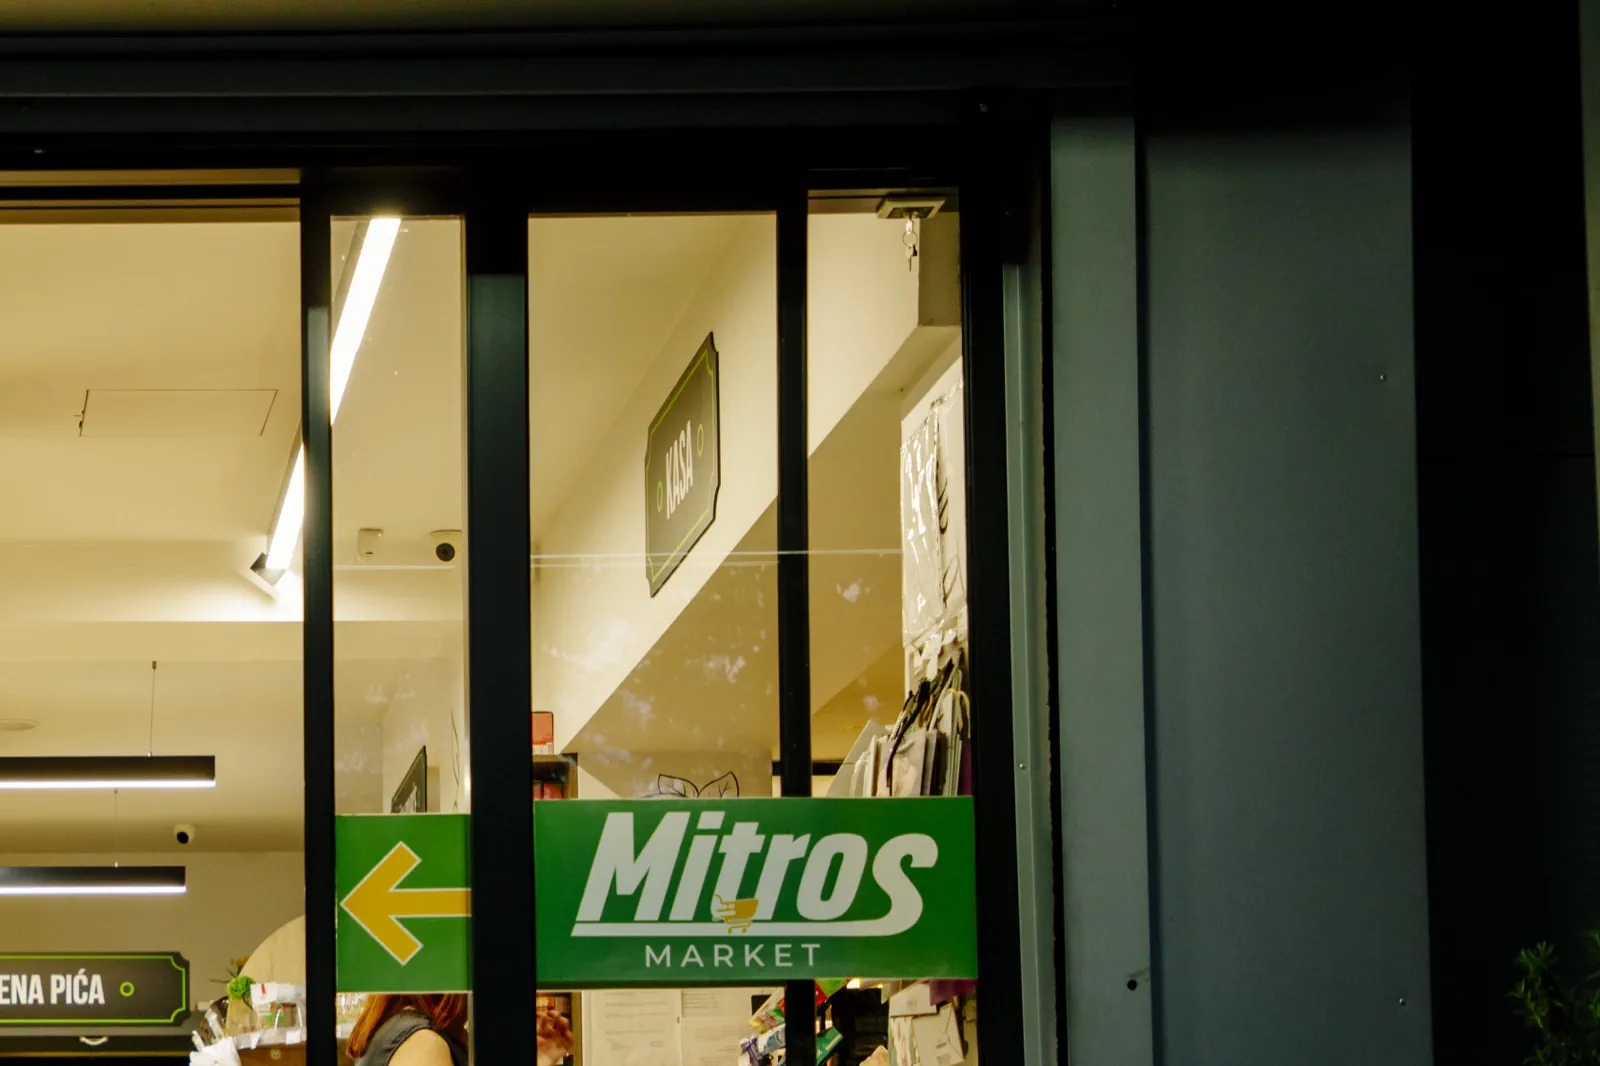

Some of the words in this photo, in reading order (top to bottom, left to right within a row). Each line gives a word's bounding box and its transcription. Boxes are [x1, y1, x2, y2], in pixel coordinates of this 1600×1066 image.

[665, 420, 693, 520] KASA
[570, 810, 938, 937] Mitros
[50, 968, 105, 1005] PIĆA
[645, 944, 821, 968] MARKET
